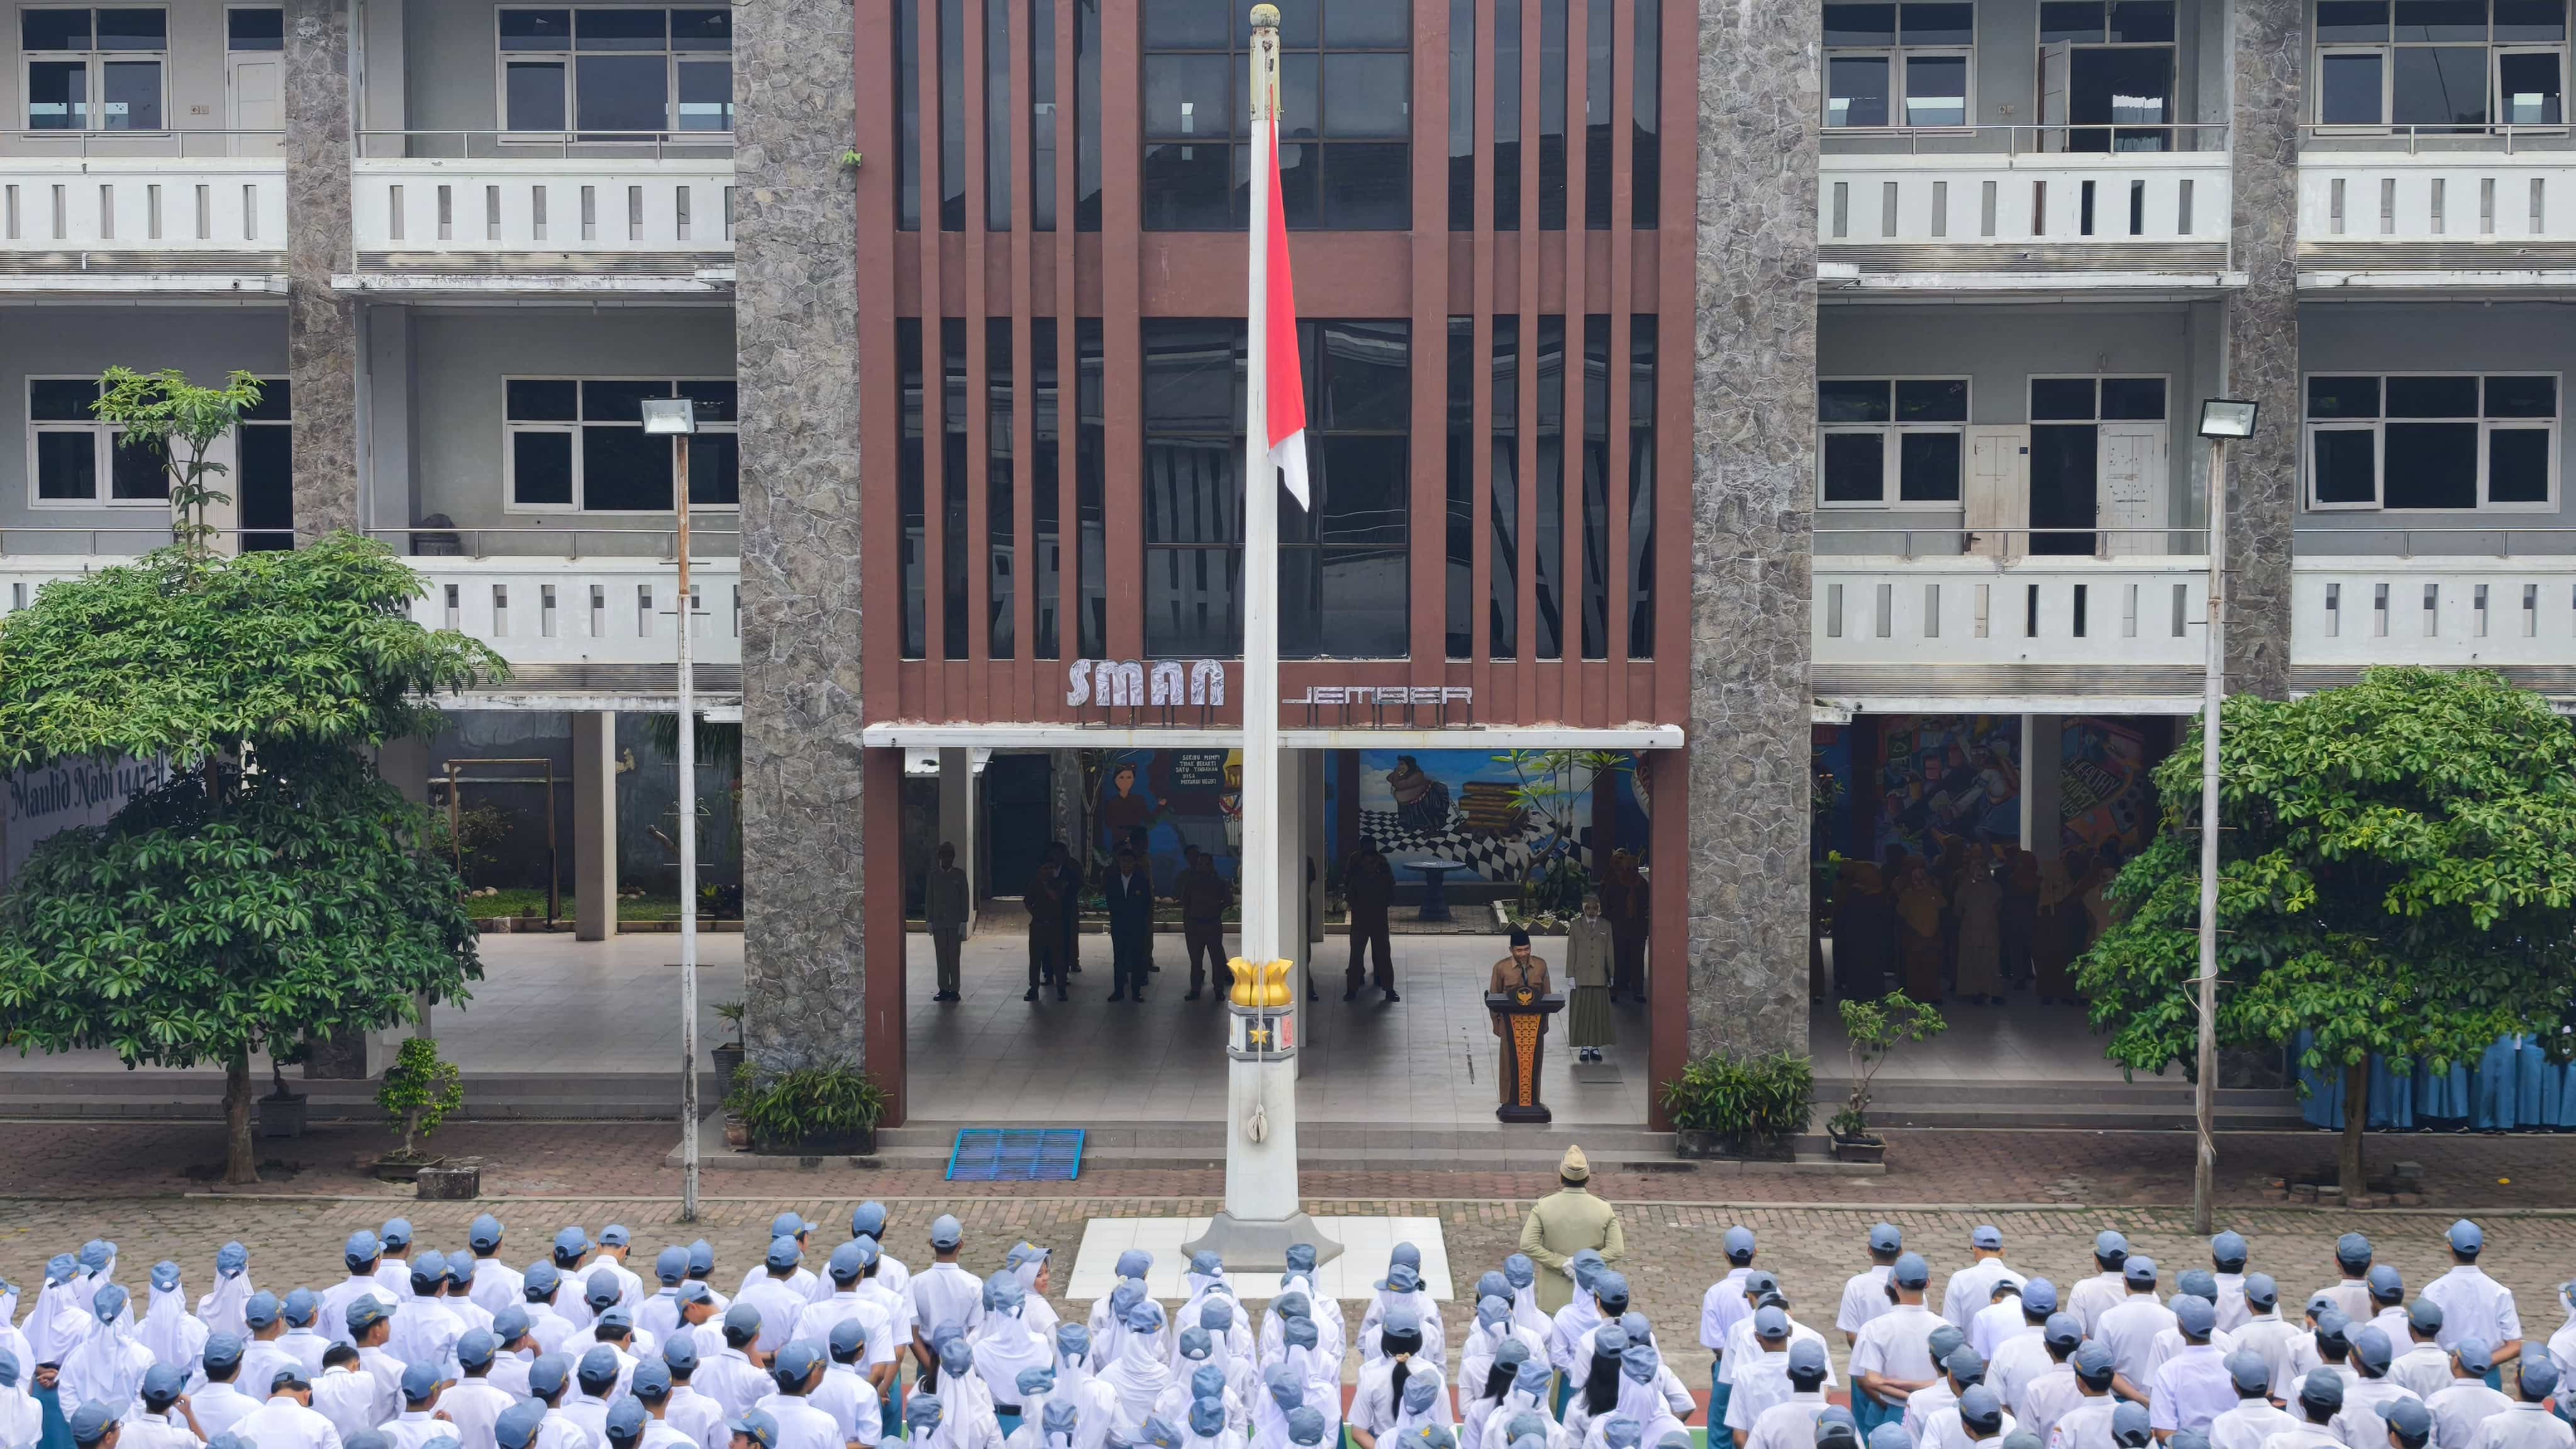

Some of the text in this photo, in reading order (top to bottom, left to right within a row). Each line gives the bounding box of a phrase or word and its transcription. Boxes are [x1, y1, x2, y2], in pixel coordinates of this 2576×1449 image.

[1282, 686, 1472, 705] JEMBER
[10, 769, 70, 822] Maulid
[74, 764, 113, 809] Nabi
